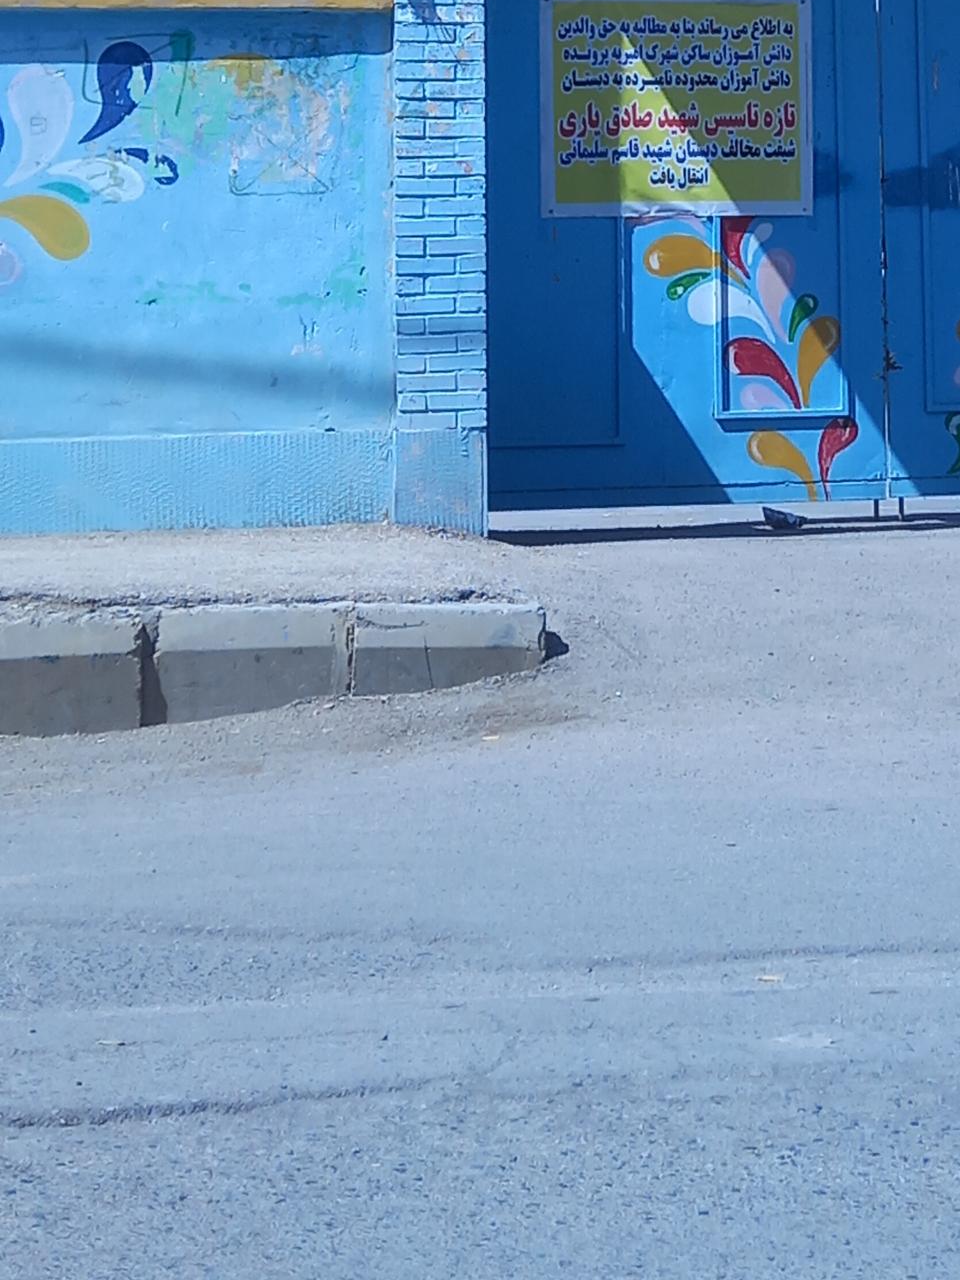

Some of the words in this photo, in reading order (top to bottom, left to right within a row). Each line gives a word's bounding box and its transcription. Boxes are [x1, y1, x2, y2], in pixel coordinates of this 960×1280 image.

[557, 17, 596, 40] والدین
[597, 19, 617, 39] حق
[619, 21, 631, 39] به
[632, 17, 668, 39] مطالبه
[669, 21, 680, 39] به
[682, 17, 695, 39] بنا
[697, 18, 729, 40] رساند
[730, 24, 749, 40] می
[750, 18, 781, 41] اطلاع
[782, 23, 794, 40] به
[563, 46, 609, 66] پرونده
[611, 44, 643, 66] امیریه
[645, 43, 680, 66] شهرک
[681, 43, 711, 66] ساکن
[712, 42, 760, 66] آموزان
[762, 44, 792, 66] دانش
[562, 69, 610, 92] دبستان
[611, 73, 623, 90] به
[625, 69, 673, 92] نامبرده
[674, 72, 719, 92] محدوده
[720, 67, 760, 92] آموزان
[761, 70, 792, 92] دانش
[559, 101, 600, 138] یاری
[606, 101, 653, 137] صادق
[657, 102, 699, 135] شهید
[704, 101, 759, 136] تاسیس
[763, 101, 796, 138] تازه
[559, 139, 609, 166] سلیمانی
[611, 137, 640, 165] قاسم
[642, 139, 673, 163] شهید
[675, 139, 719, 163] دبستان
[720, 138, 761, 159] مخالف
[763, 139, 796, 163] شیفت
[649, 166, 675, 189] یافت
[677, 168, 709, 190] انتقال
